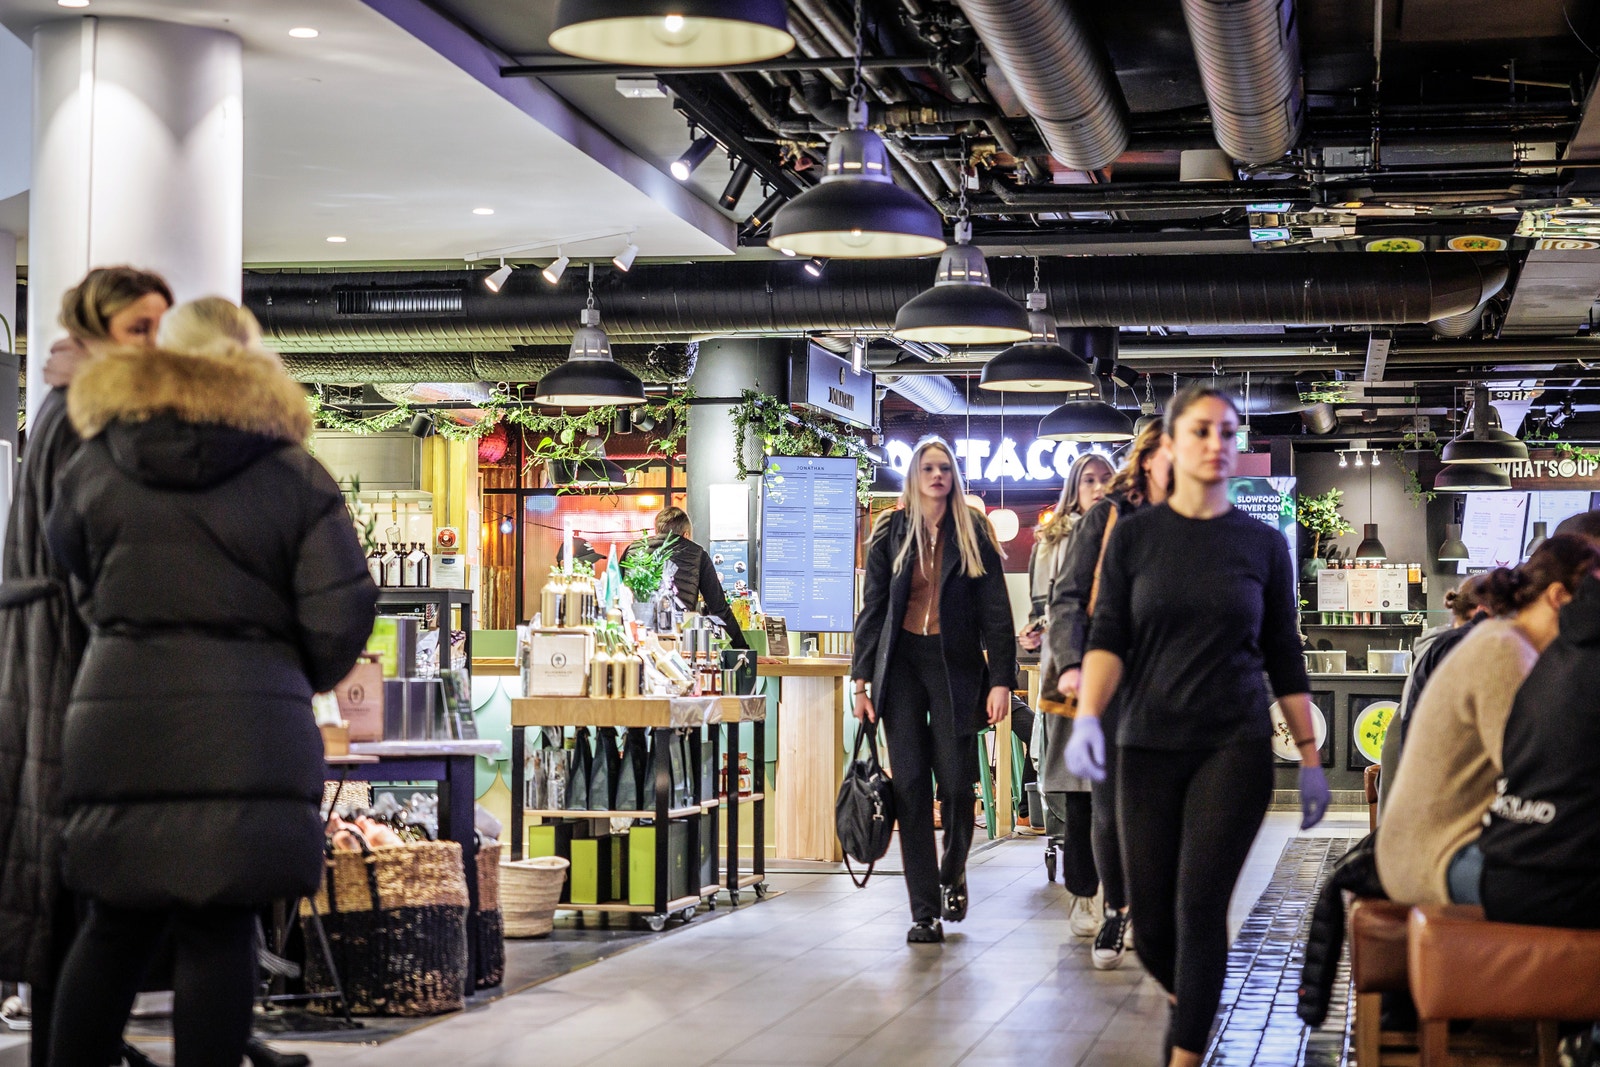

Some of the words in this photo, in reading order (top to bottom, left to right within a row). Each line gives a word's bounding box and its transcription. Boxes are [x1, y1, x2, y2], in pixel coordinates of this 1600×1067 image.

[955, 438, 1114, 483] TACO
[1236, 495, 1281, 503] SLOWFOOD
[1267, 504, 1285, 512] SOM
